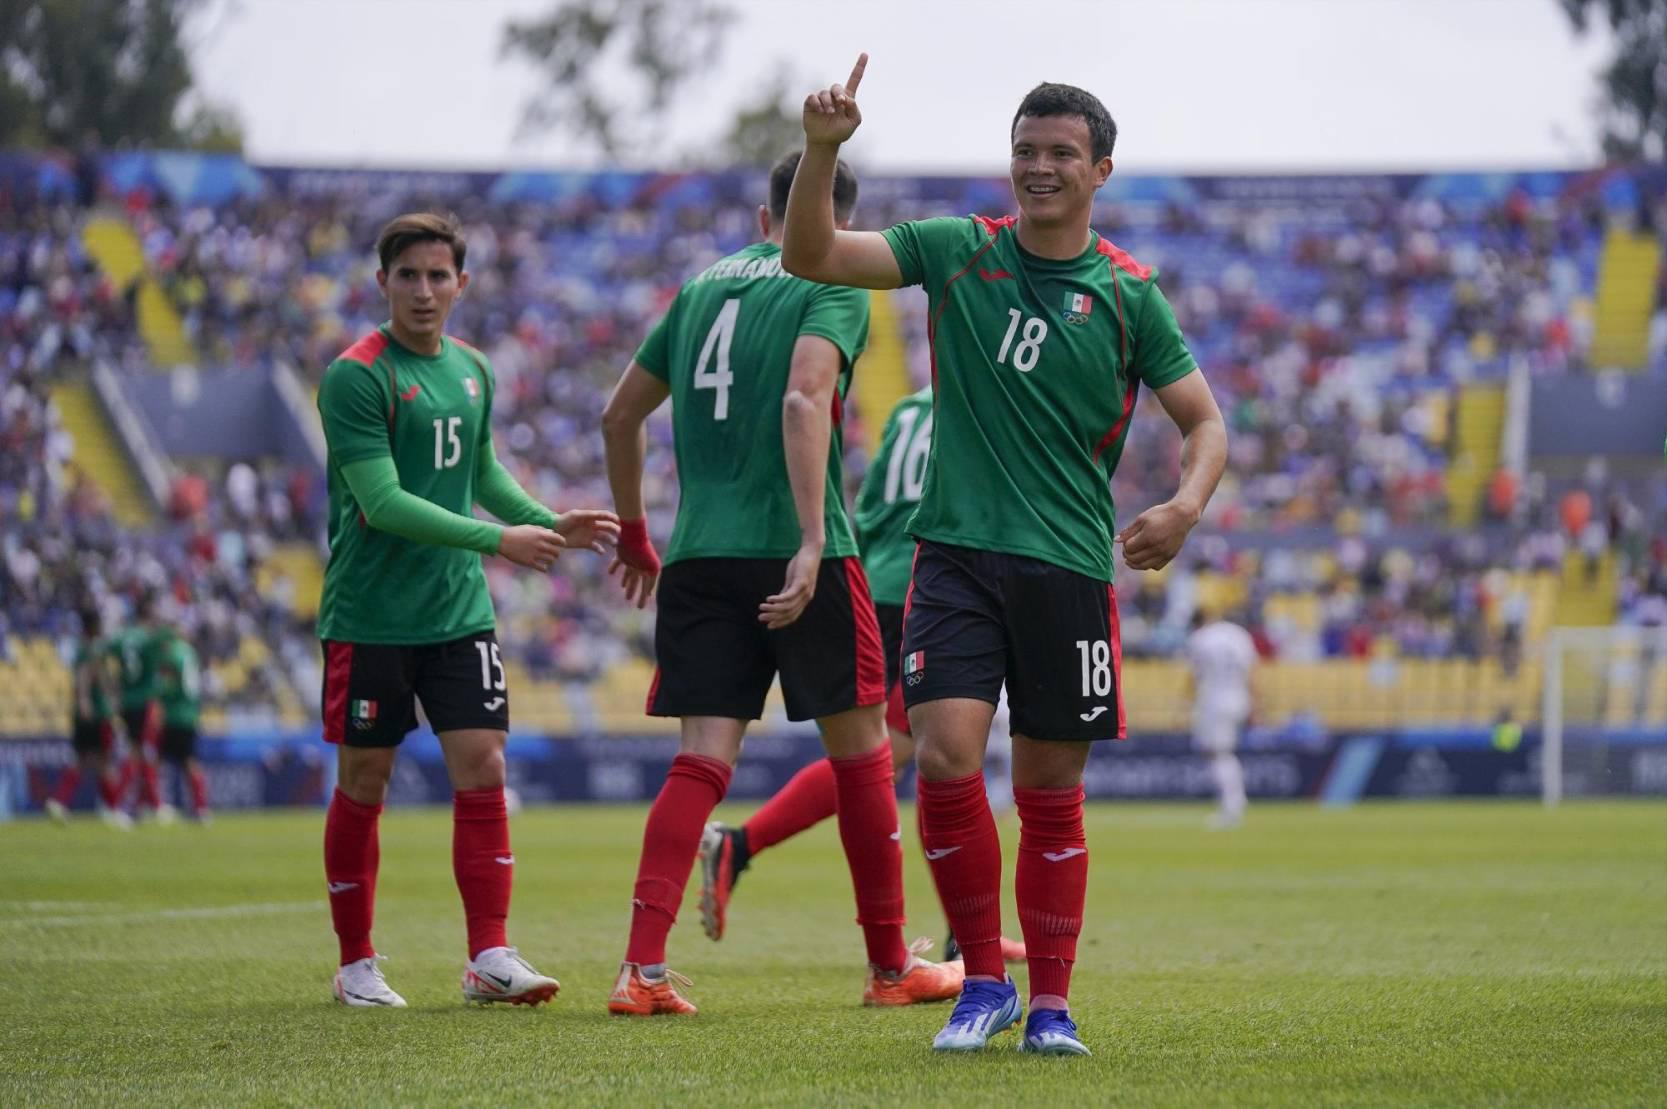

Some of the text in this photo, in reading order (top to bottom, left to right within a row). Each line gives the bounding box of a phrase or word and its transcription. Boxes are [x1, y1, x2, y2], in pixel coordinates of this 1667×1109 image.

[694, 298, 740, 420] 4
[997, 307, 1048, 373] 18
[433, 416, 462, 470] 15
[883, 406, 933, 504] 16
[475, 641, 506, 691] 15
[1076, 640, 1111, 697] 18
